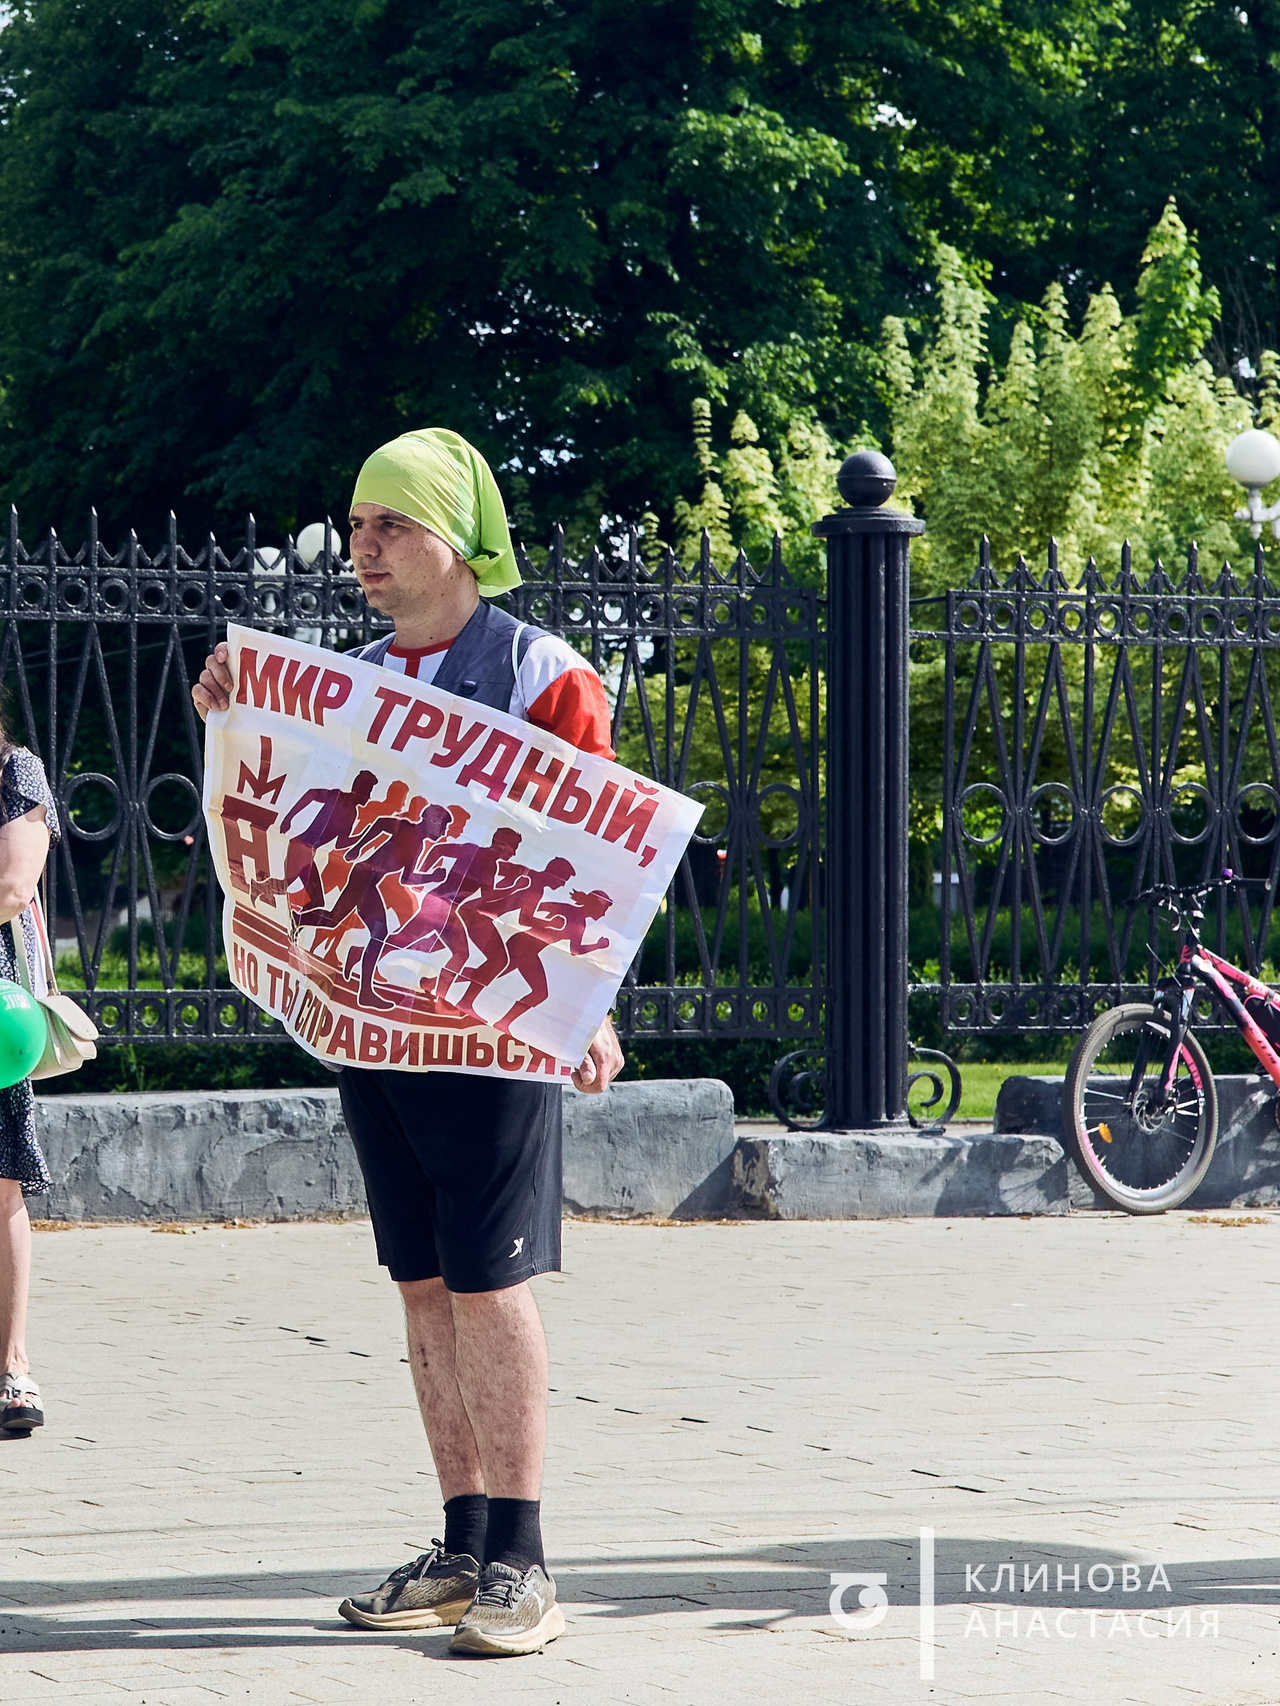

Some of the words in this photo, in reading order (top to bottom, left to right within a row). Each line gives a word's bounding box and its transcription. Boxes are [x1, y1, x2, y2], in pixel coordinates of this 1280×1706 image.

[235, 646, 354, 728] МИР
[366, 685, 660, 869] ТРУДНЫЙ,
[233, 941, 259, 996] НО
[266, 963, 300, 1022] ТЫ
